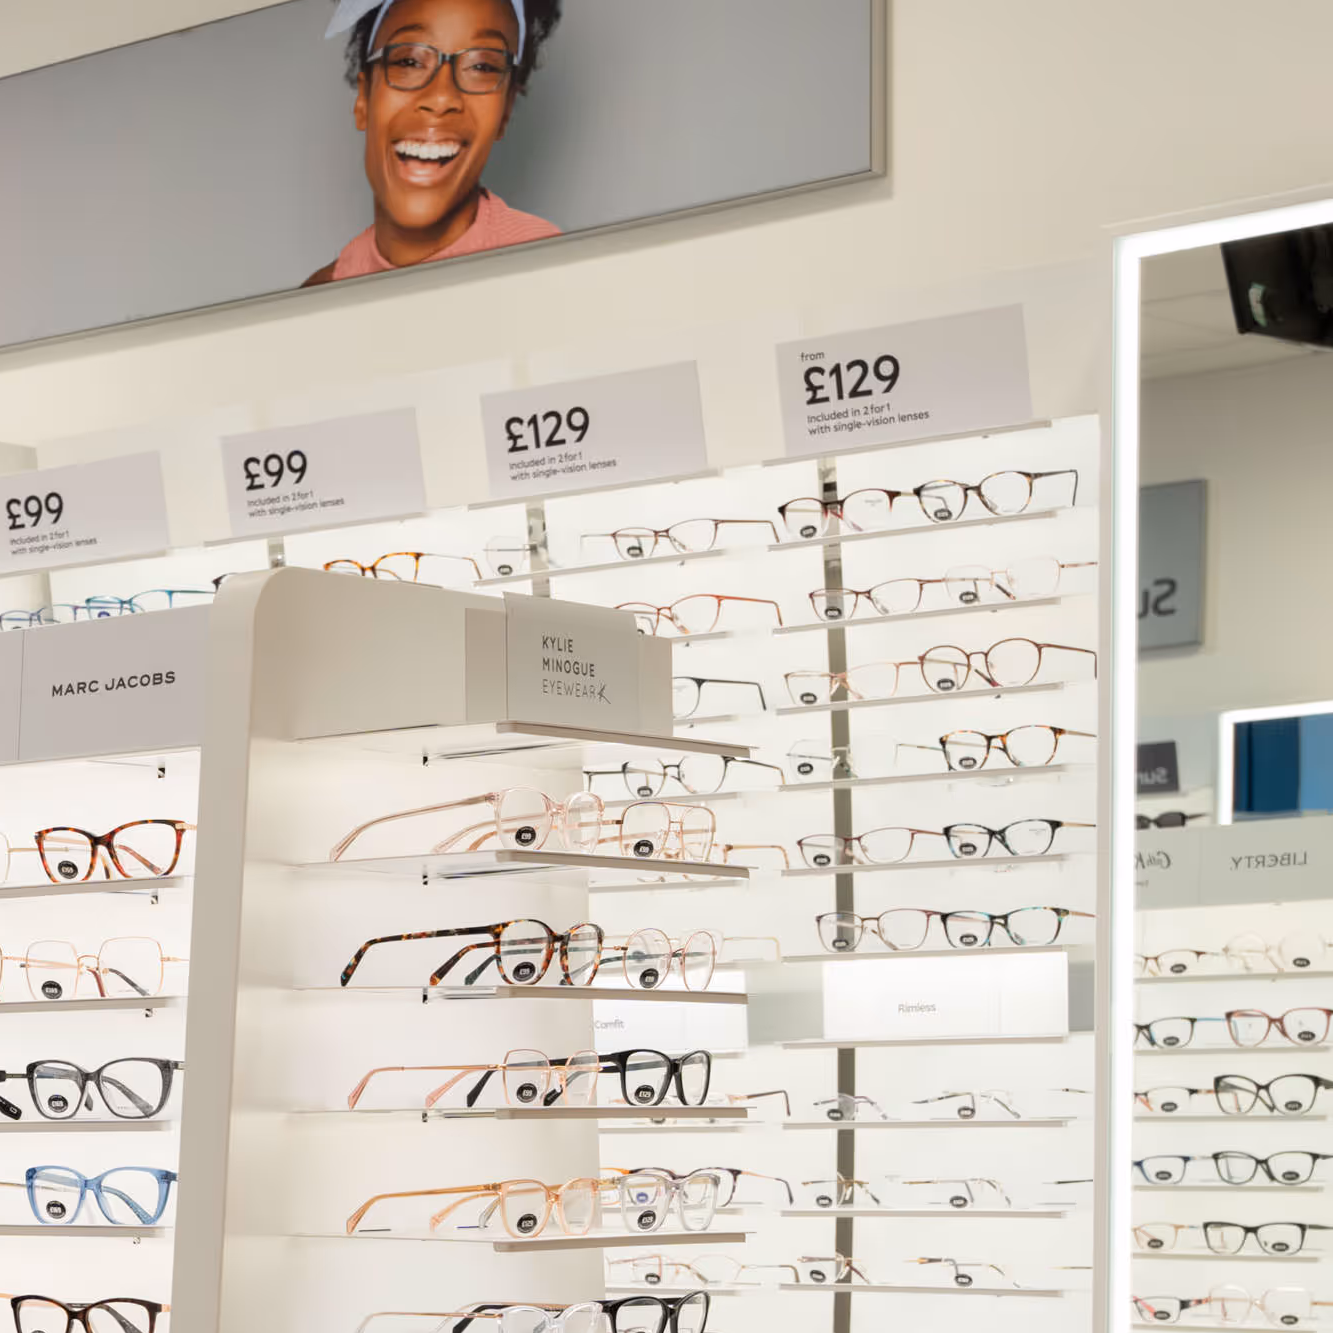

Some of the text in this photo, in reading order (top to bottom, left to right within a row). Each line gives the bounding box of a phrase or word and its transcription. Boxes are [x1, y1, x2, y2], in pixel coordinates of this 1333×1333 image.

[803, 354, 900, 405] £129
[852, 408, 861, 417] in
[504, 406, 590, 453] £129
[808, 411, 930, 435] with single-vision lenses
[548, 456, 556, 465] in
[243, 450, 308, 492] £99
[511, 472, 530, 481] with
[6, 491, 64, 531] £99
[542, 635, 574, 653] KYLIE
[542, 658, 595, 678] MINOGUE
[51, 671, 176, 698] MARC JACOBS
[542, 679, 596, 699] EYEWEAR
[898, 1002, 936, 1013] Rimless
